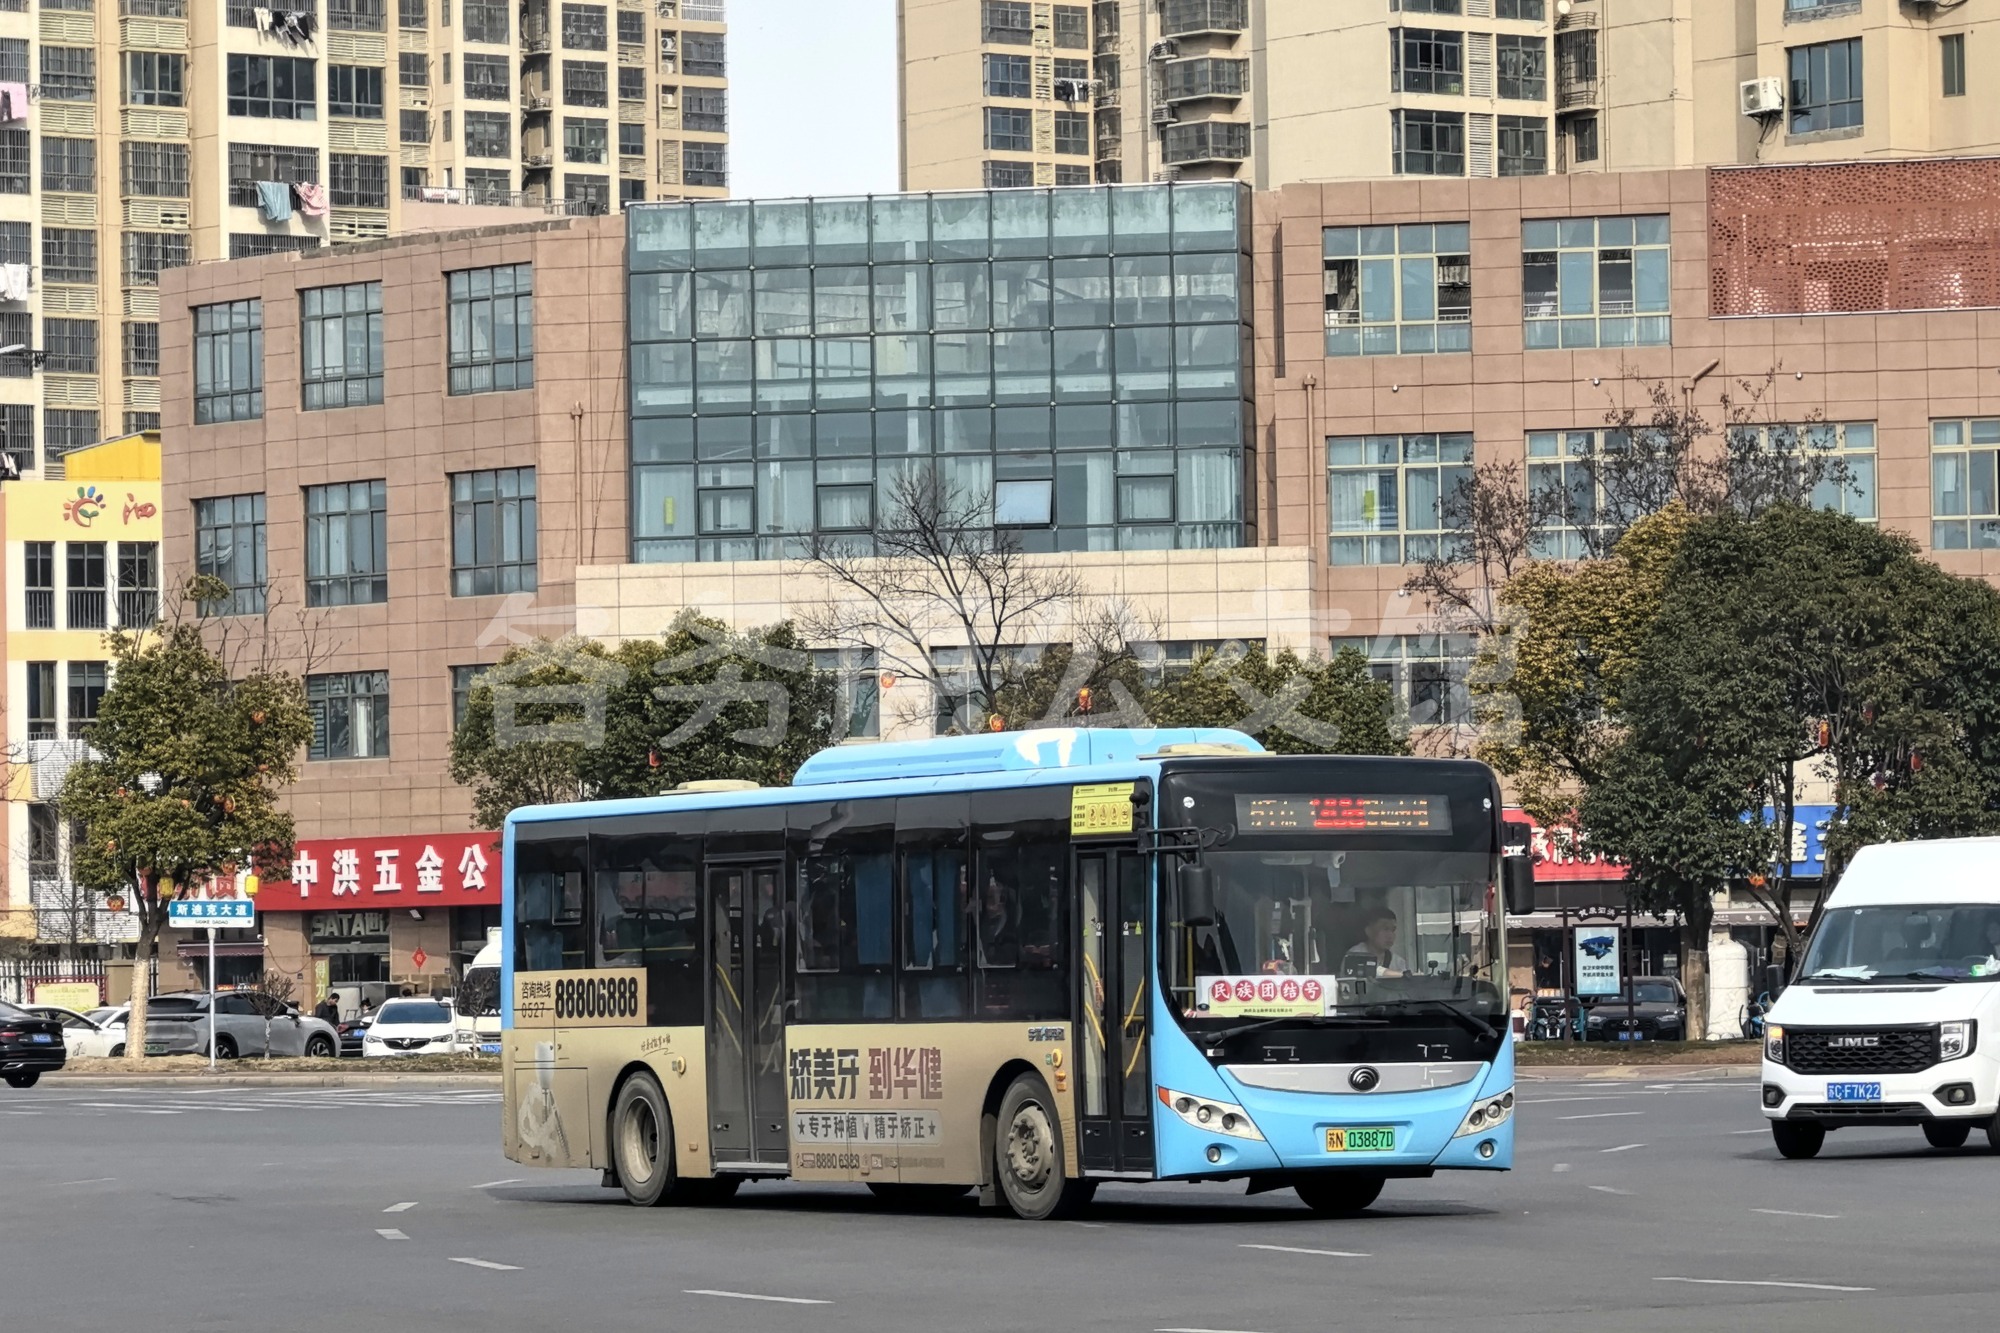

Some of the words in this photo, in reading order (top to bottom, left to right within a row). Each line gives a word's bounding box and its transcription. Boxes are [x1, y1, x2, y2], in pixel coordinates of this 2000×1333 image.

[291, 844, 488, 898] 中洪五金公
[176, 903, 247, 916] 斯迪克大道
[315, 960, 326, 1003] 得力
[521, 980, 552, 999] 咨询热线
[1212, 982, 1320, 999] 民族团结号
[555, 976, 639, 1019] 88806888
[521, 1002, 546, 1018] 0527
[1828, 1037, 1879, 1047] JMC
[789, 1047, 860, 1100] 矫美牙
[868, 1046, 943, 1100] 到华健
[808, 1115, 858, 1139] 专于种植
[874, 1115, 926, 1139] 精于矫正
